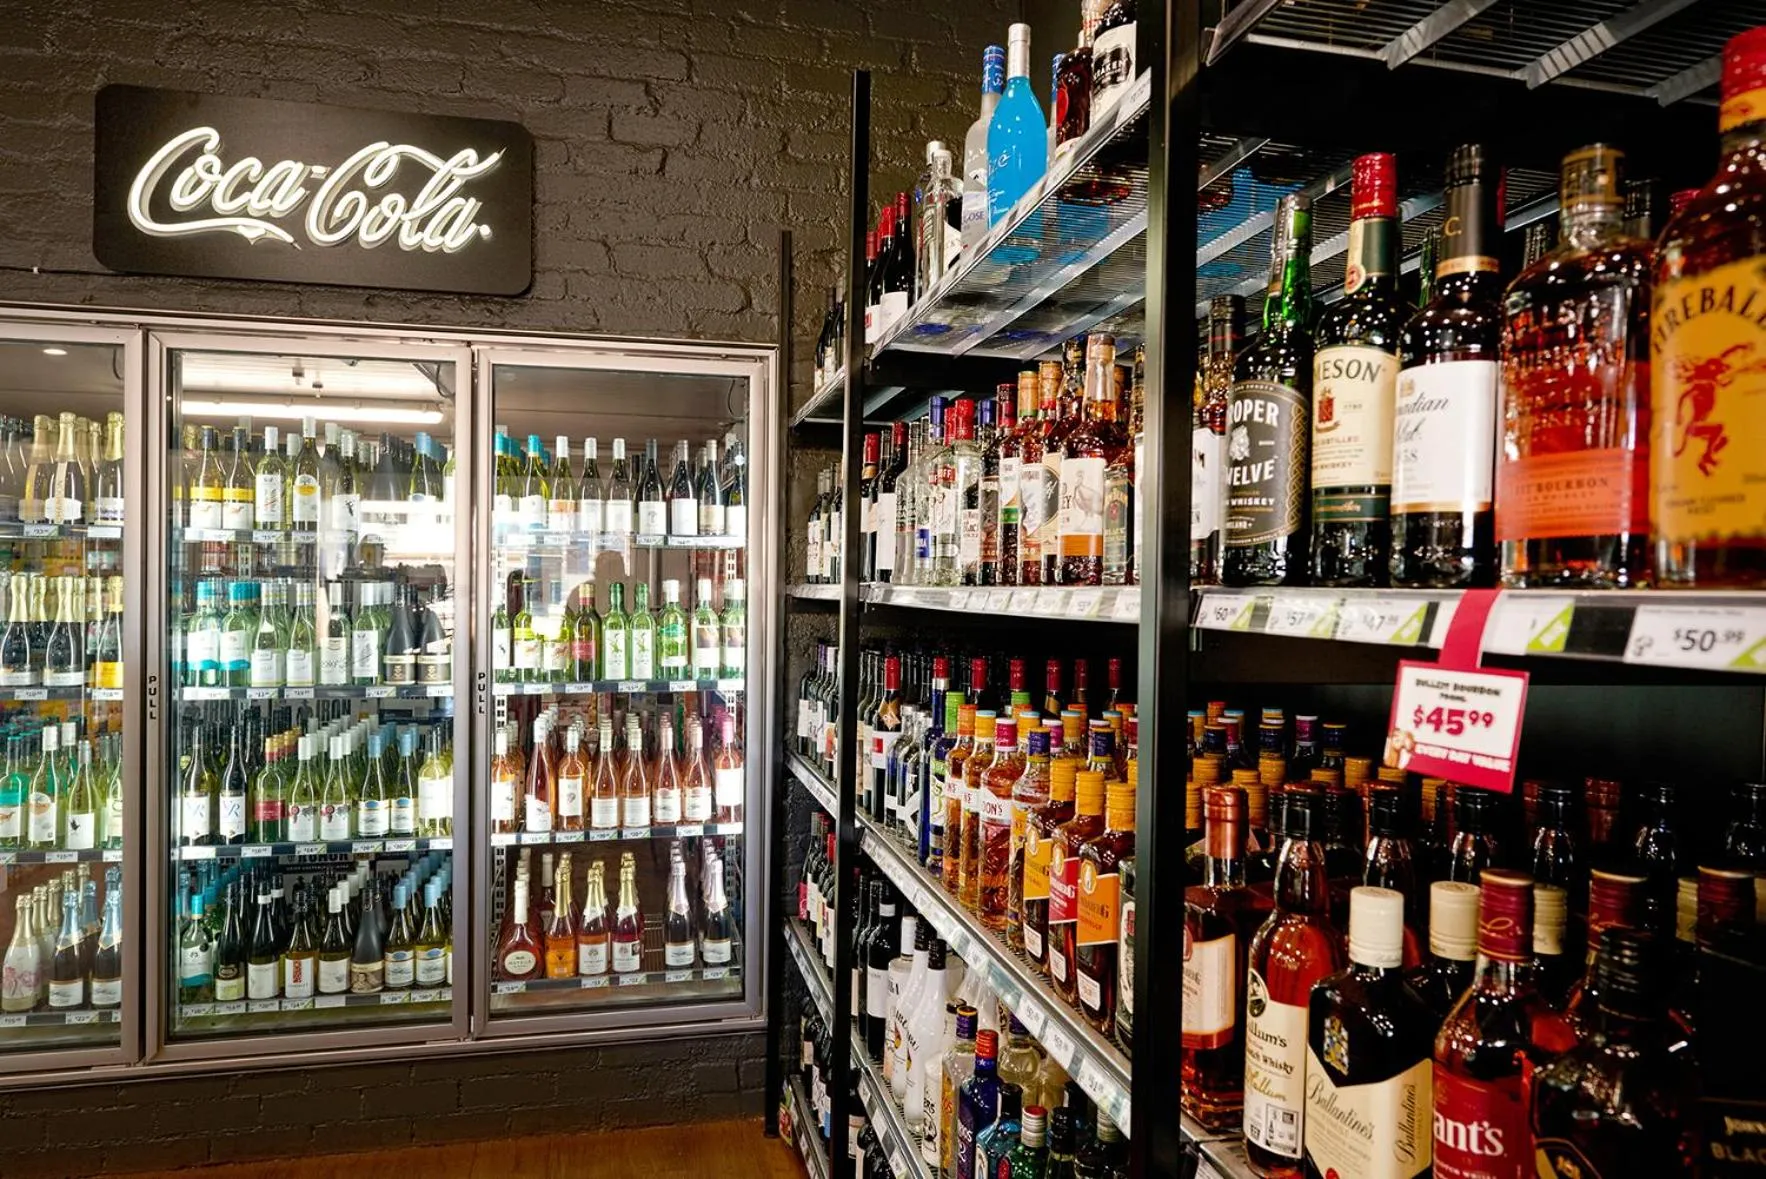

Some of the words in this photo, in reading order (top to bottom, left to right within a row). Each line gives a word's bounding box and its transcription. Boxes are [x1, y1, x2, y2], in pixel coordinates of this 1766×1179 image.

[128, 126, 506, 253] Coca-Cola
[1316, 358, 1381, 383] ESON
[148, 675, 158, 720] PULL
[477, 672, 487, 715] PULL
[1453, 684, 1501, 697] BOURBON
[1434, 1108, 1505, 1157] ant's
